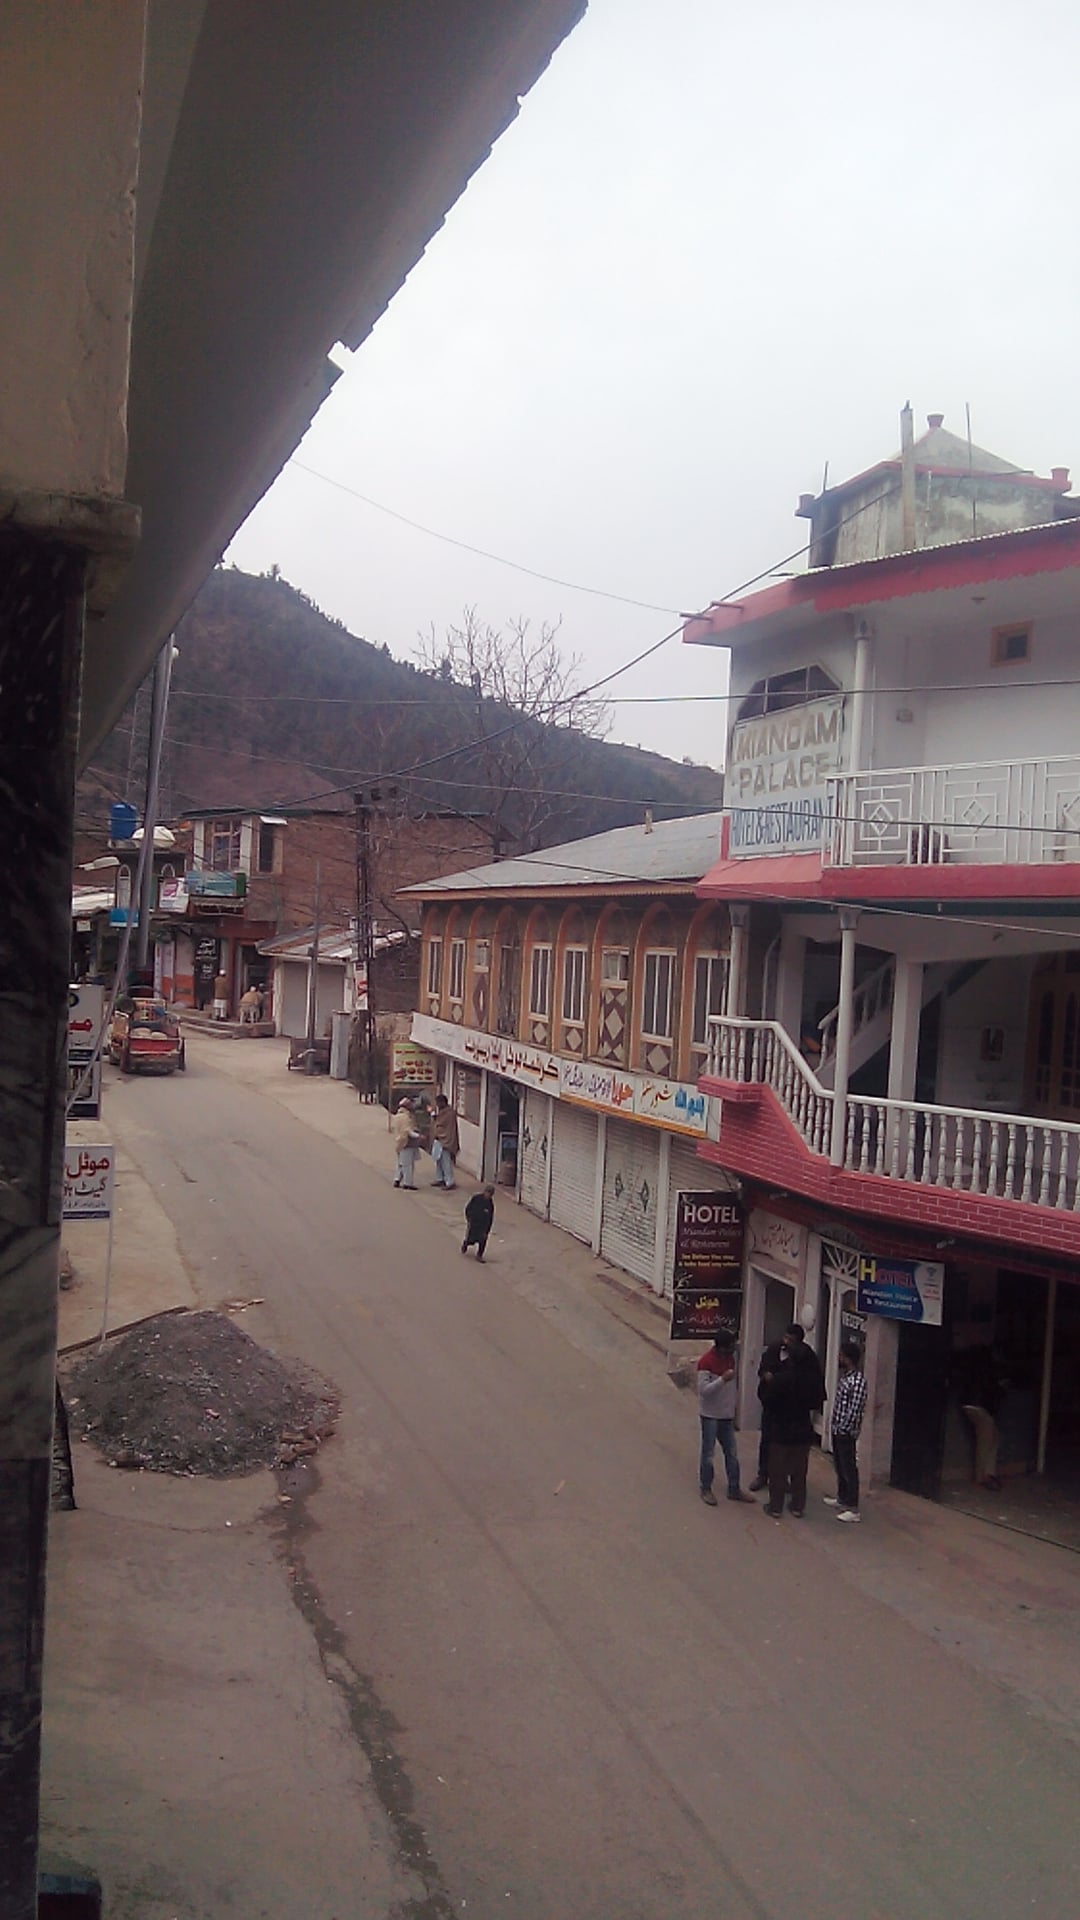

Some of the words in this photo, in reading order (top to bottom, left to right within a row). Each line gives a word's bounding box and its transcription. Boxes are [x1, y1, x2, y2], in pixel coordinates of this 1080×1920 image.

[736, 709, 839, 762] MIANDAM
[738, 751, 832, 799] PALACE
[683, 1204, 740, 1224] HOTEL
